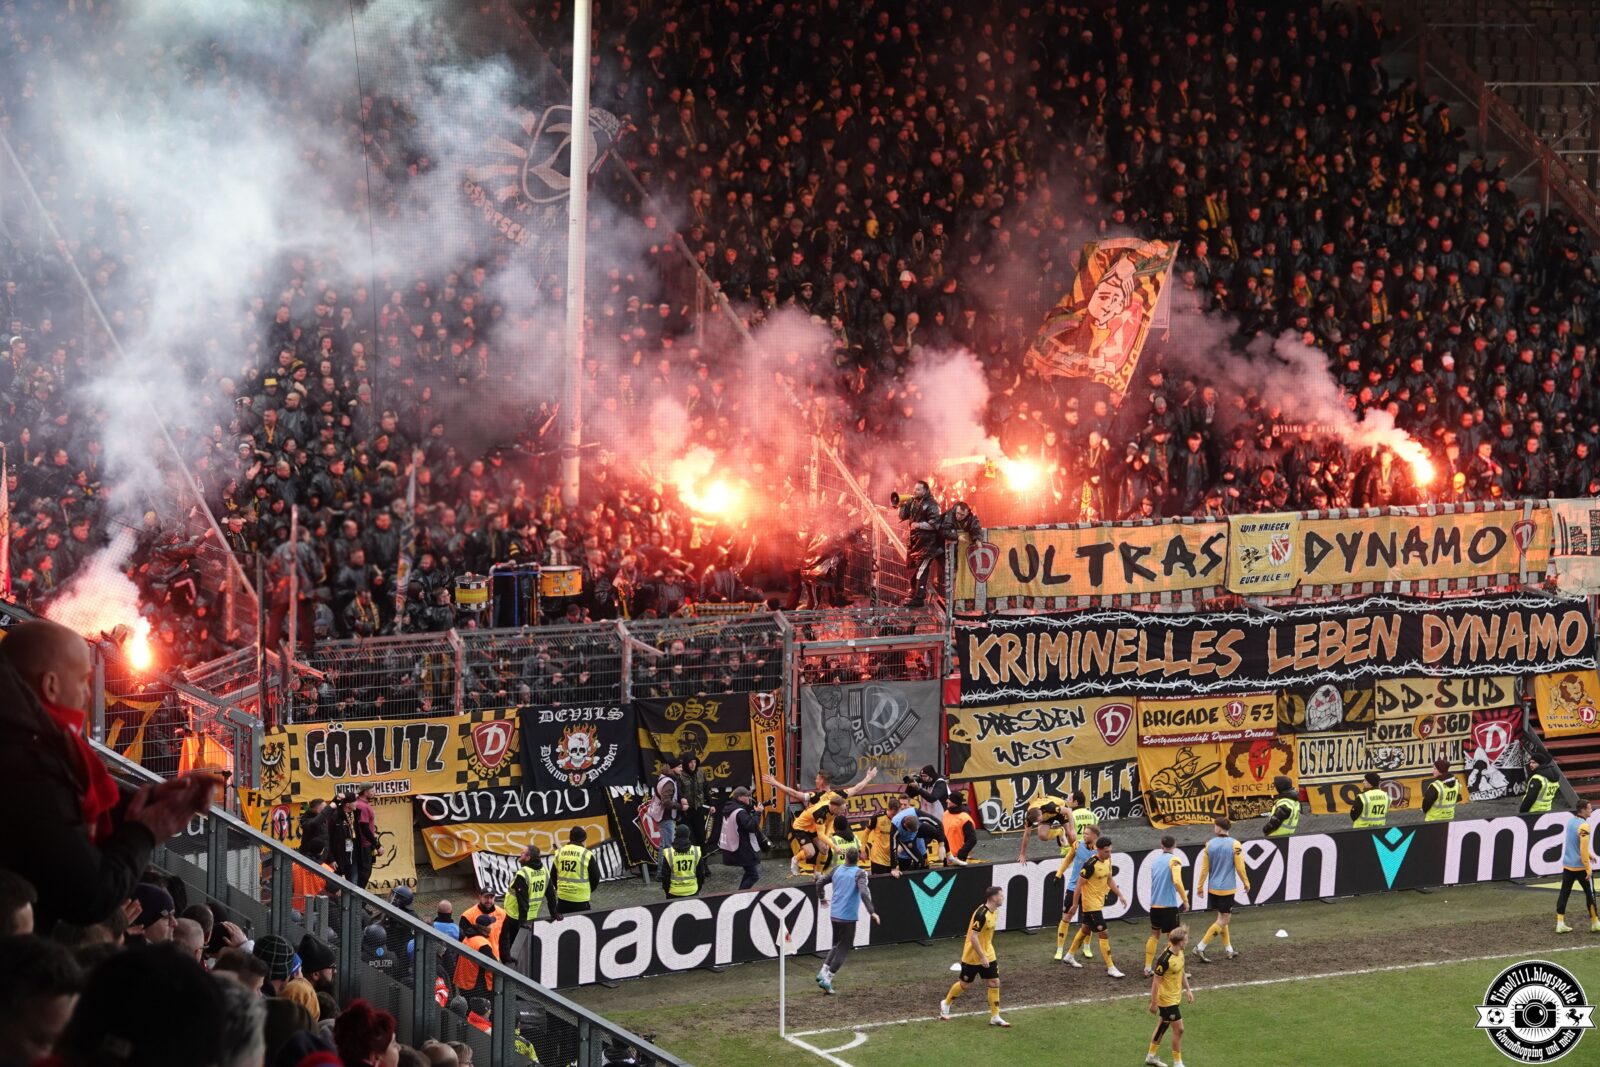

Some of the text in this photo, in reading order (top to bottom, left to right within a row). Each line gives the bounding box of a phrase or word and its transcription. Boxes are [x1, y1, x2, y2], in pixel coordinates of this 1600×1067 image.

[1240, 524, 1256, 532] WIR
[1008, 532, 1225, 587] ULTRAS
[1304, 525, 1507, 574] DYNAMO
[1262, 573, 1281, 582] ALLE
[969, 610, 1588, 686] KRIMINELLES LEBEN DYNAMO
[538, 707, 624, 723] DEVILS
[972, 705, 1086, 742] DRESDEN
[1143, 703, 1274, 728] BRIGADE 53
[1437, 713, 1470, 734] SGD
[1143, 729, 1274, 745] Sportgemeinschaft Dynamo Dresden
[306, 722, 449, 779] GÖRLITZ
[993, 736, 1076, 767] WEST
[1406, 740, 1461, 765] DYNAM
[468, 749, 514, 779] DRESDEN
[335, 780, 410, 796] NIEDHLESIEN
[416, 789, 590, 821] DYNAMO
[1371, 804, 1386, 815] 472
[560, 860, 577, 872] 152
[676, 859, 693, 871] 137
[367, 878, 417, 889] NAMO
[532, 880, 544, 893] 166
